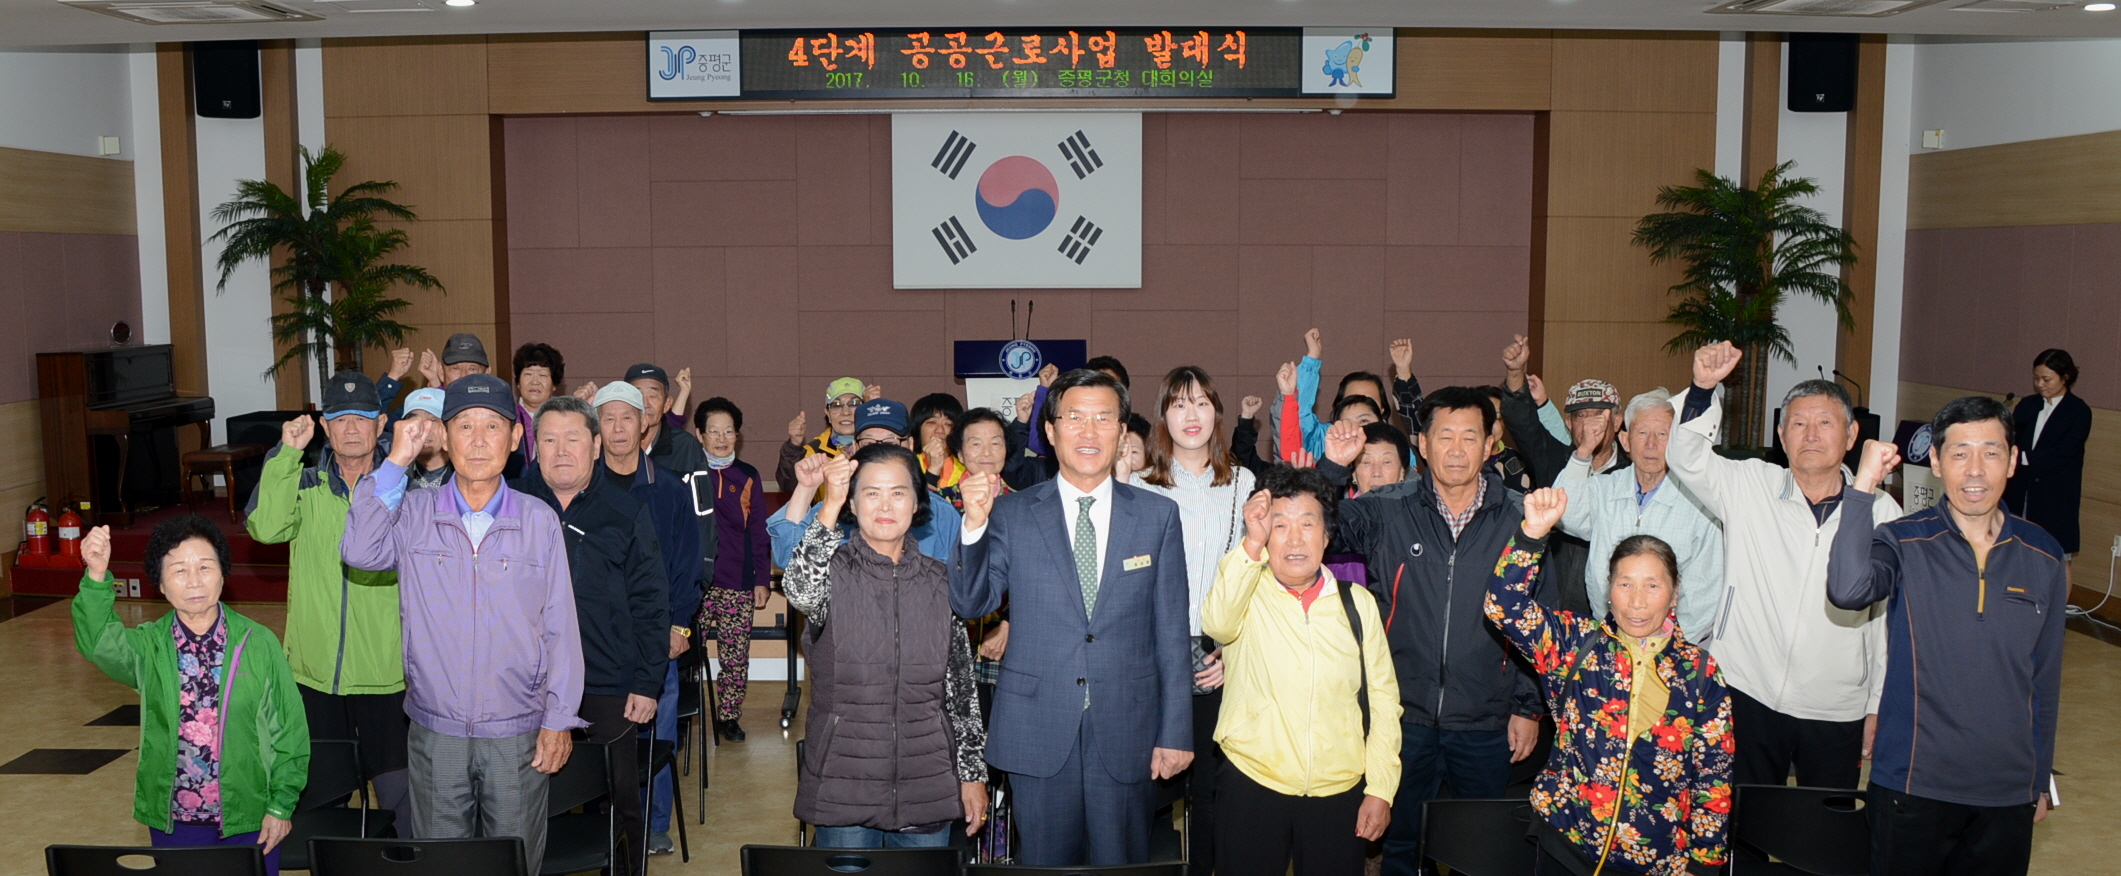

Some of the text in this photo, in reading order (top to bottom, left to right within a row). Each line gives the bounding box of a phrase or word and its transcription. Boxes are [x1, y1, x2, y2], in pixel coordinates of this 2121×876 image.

[788, 31, 1247, 70] 4단계 공공근로사업 발대식
[698, 53, 731, 72] 증평군
[686, 74, 731, 82] Jeung Pyeong
[826, 69, 1213, 88] 2017. 10. 16. (월) 증평군청 대회의실
[1914, 486, 1934, 507] 증평군
